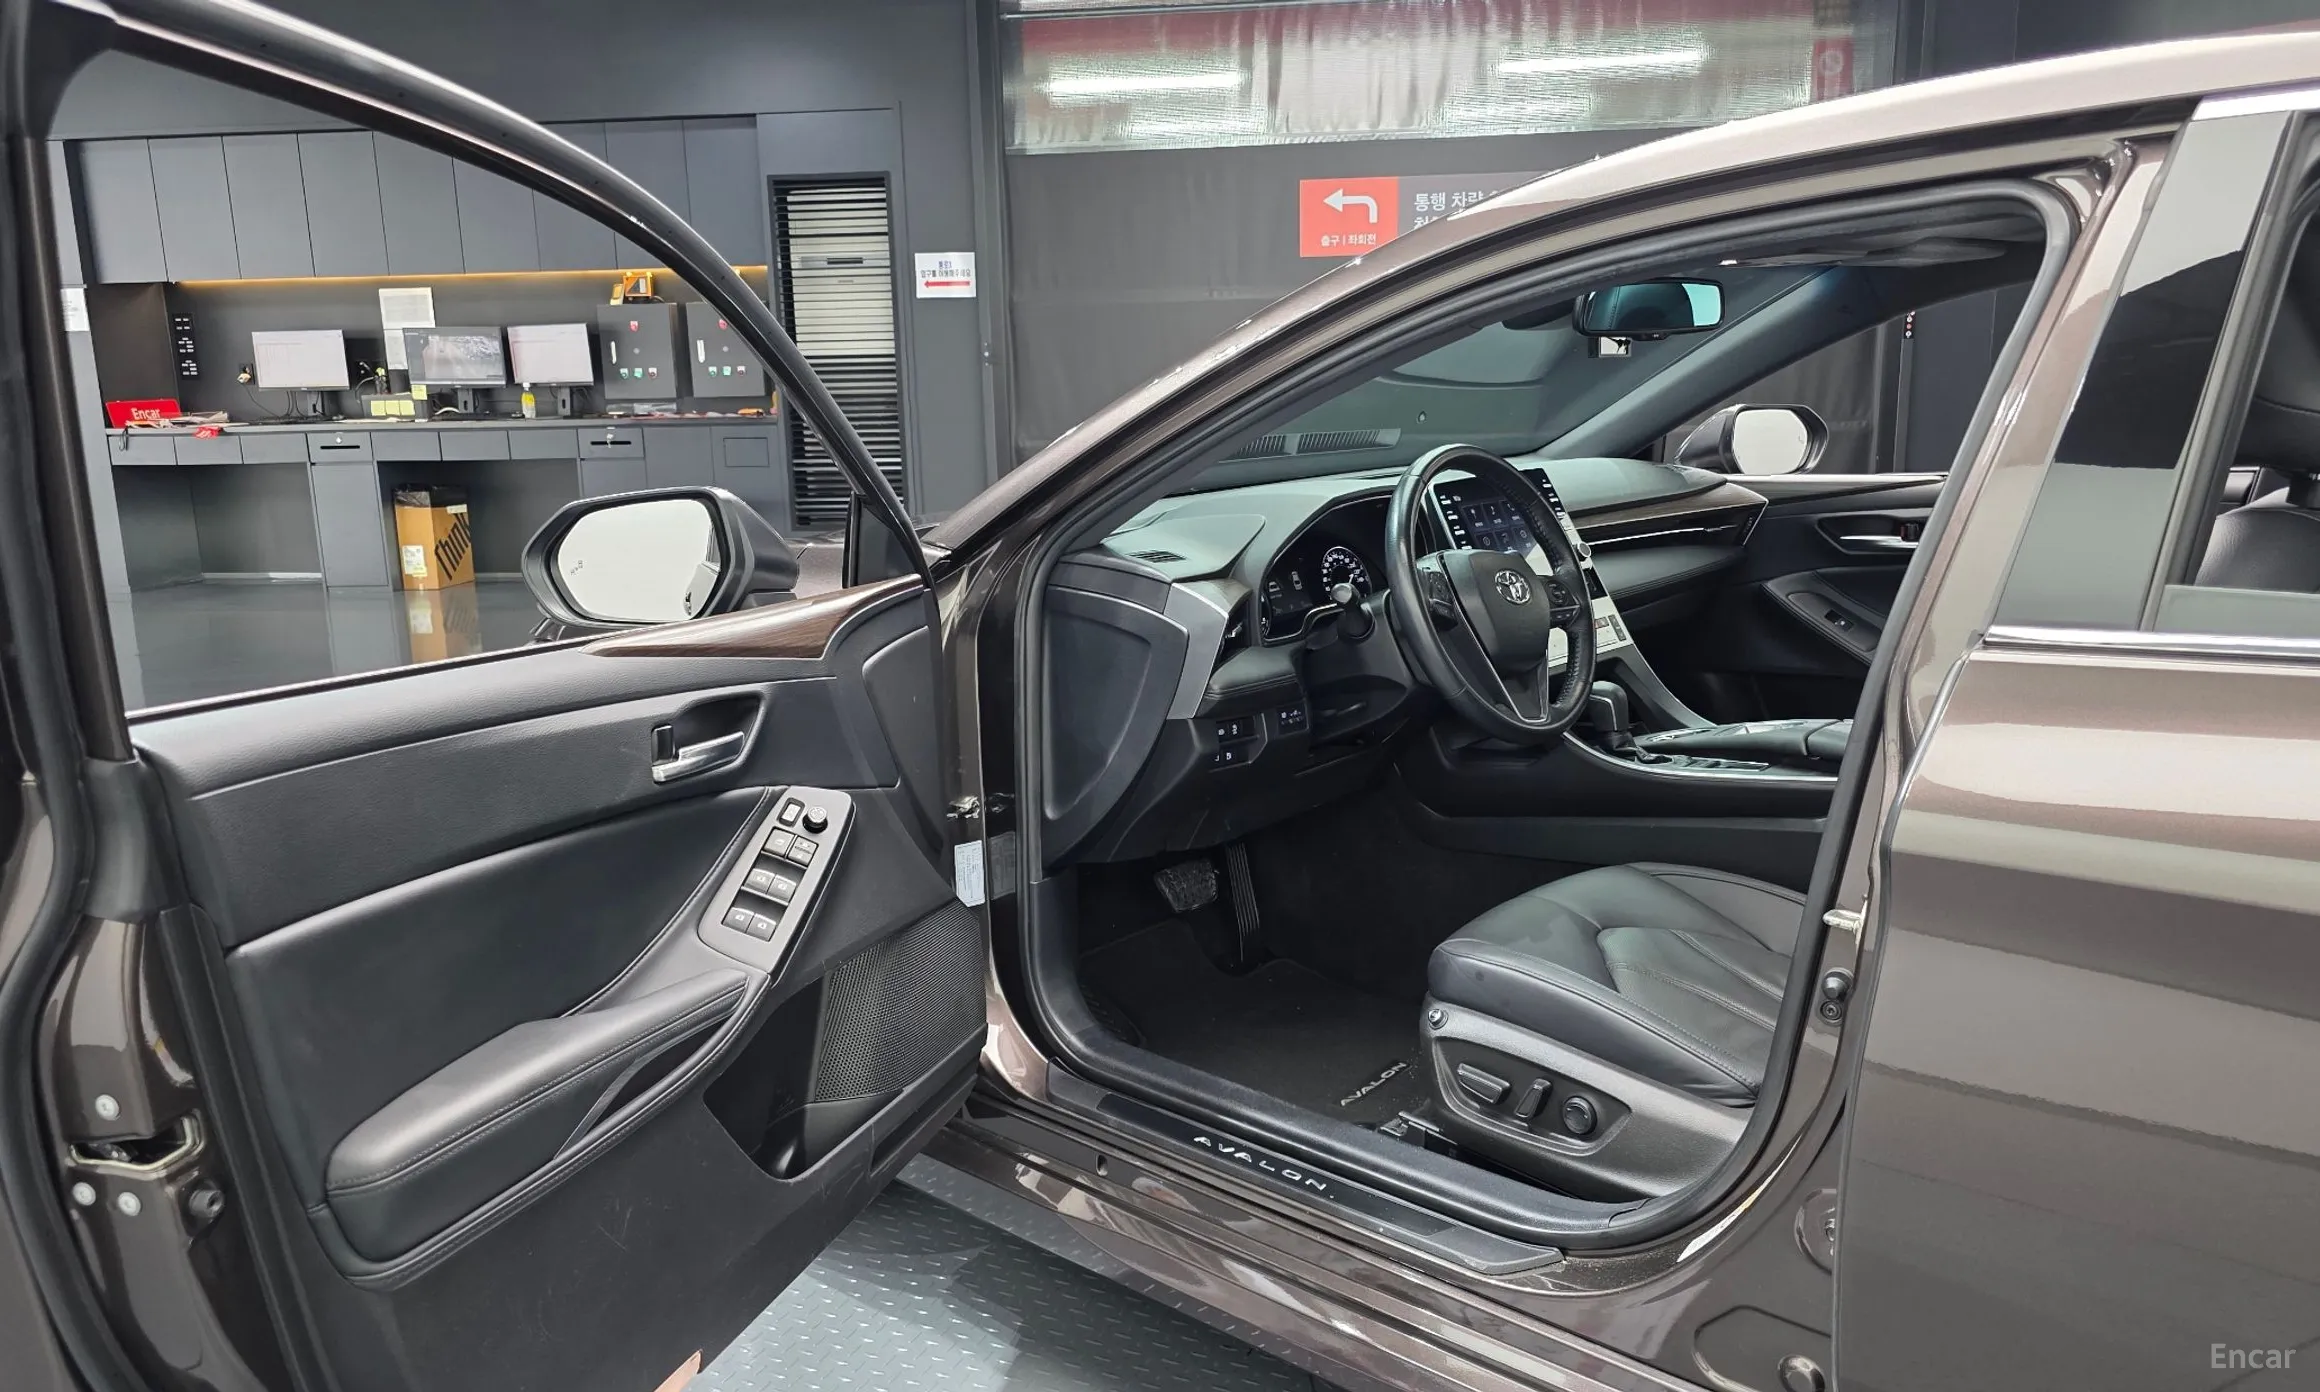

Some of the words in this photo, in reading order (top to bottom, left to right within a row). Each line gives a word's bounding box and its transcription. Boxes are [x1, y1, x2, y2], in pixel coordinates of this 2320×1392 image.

[1414, 192, 1446, 212] 통행
[131, 407, 160, 420] Encar
[1340, 1062, 1407, 1106] AVALON
[1194, 1136, 1327, 1191] AVALON
